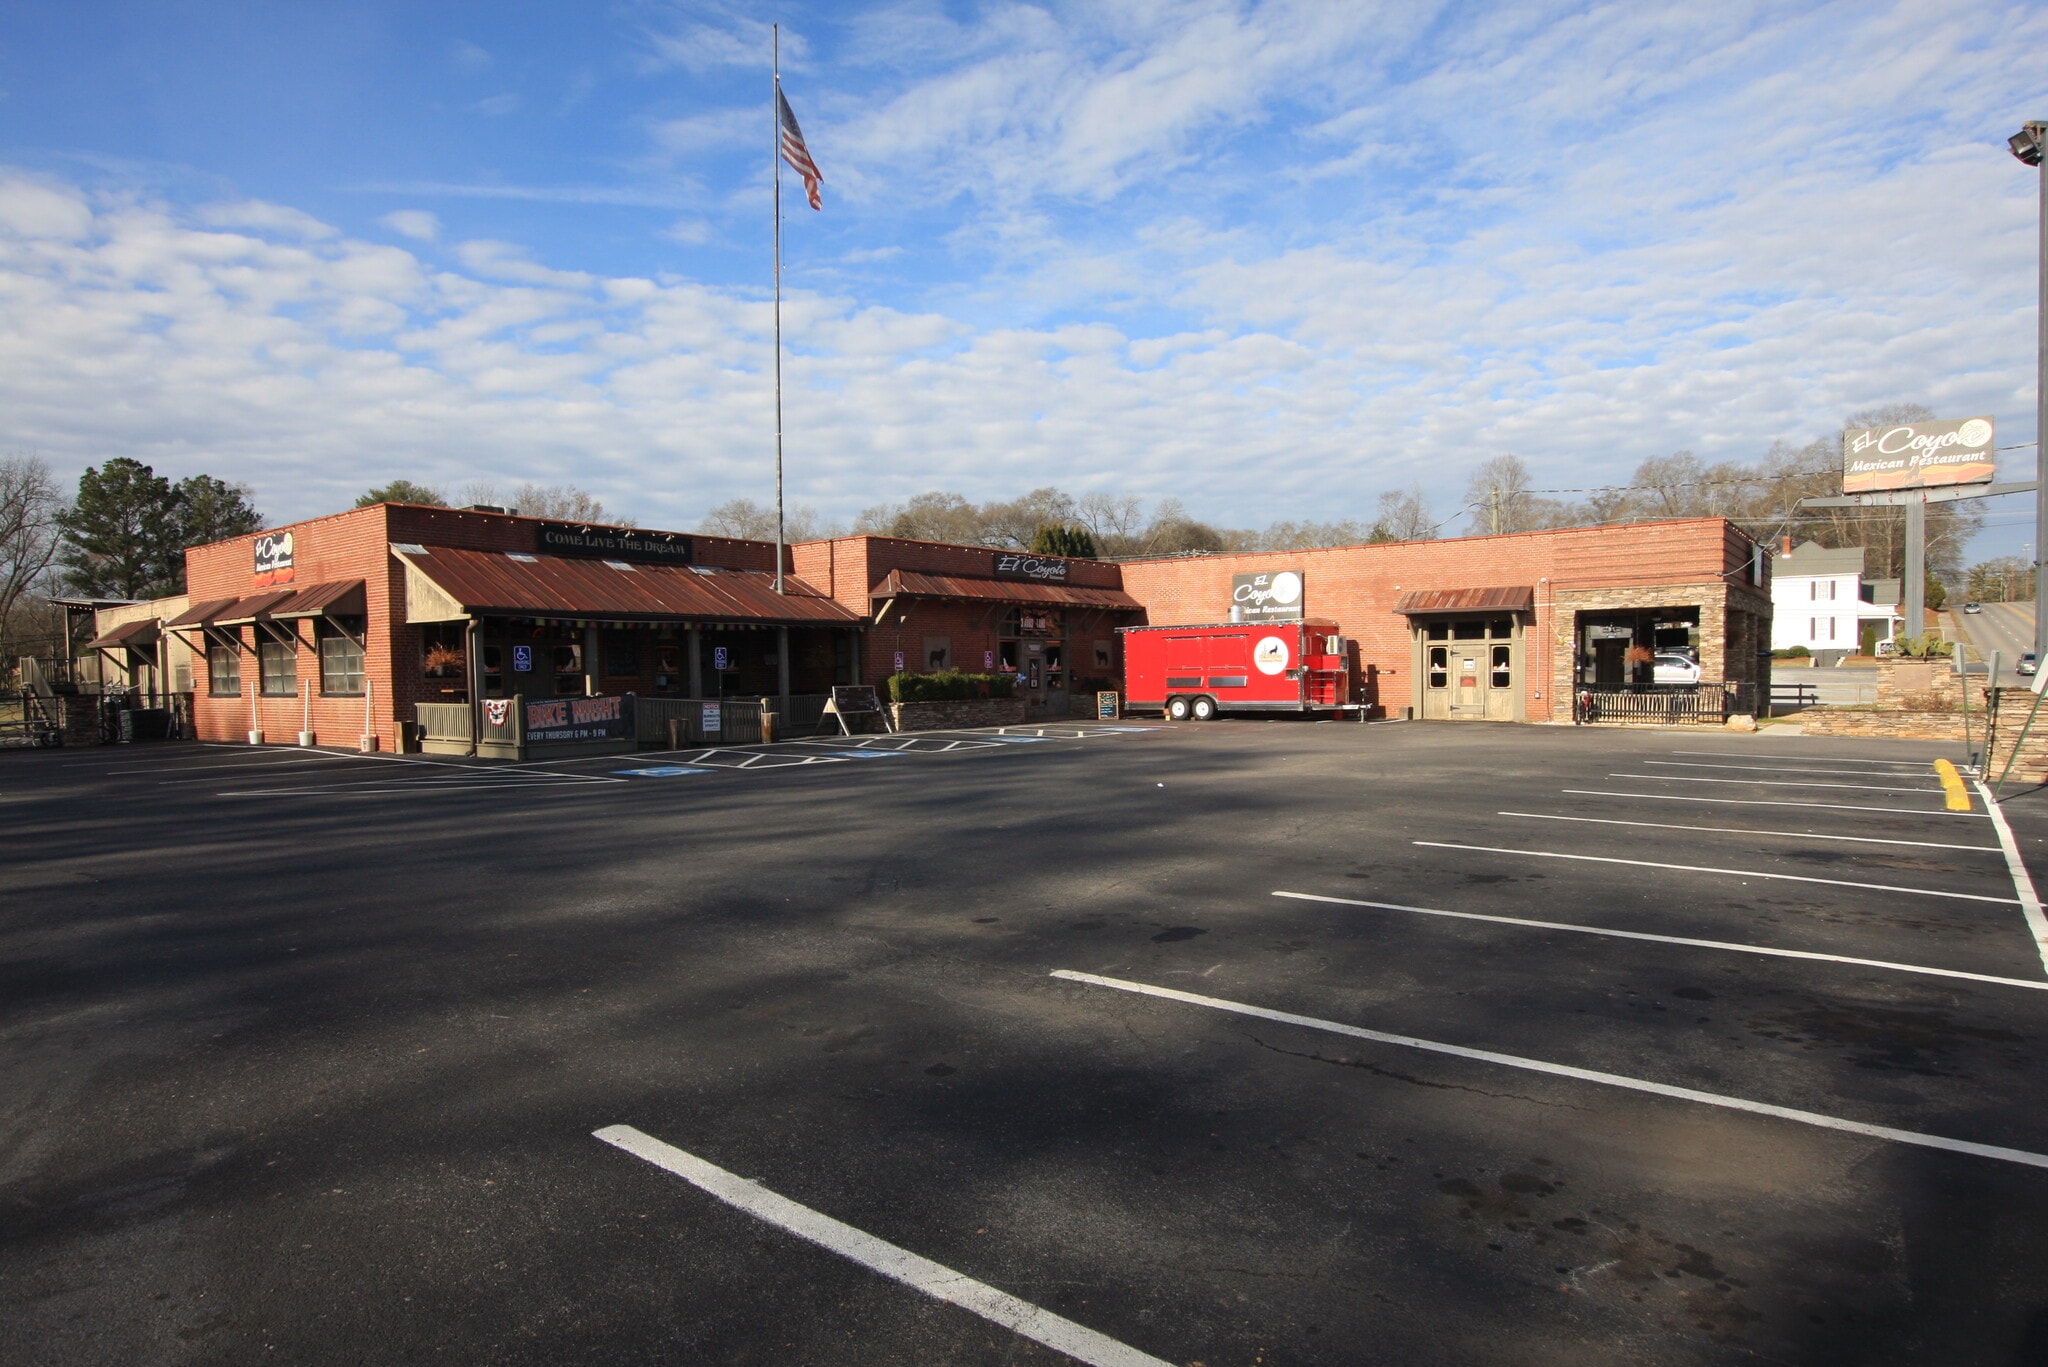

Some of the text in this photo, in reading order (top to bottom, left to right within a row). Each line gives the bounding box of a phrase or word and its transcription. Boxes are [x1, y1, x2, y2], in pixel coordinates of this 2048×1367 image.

[1850, 451, 1986, 472] Mexican Restaurant
[619, 538, 642, 551] THE
[998, 557, 1067, 579] El Coyote
[1262, 605, 1301, 614] Restaurant
[527, 696, 622, 730] BIKE NIGHT
[527, 731, 545, 741] EVERY
[545, 730, 574, 740] THURSDAY
[574, 731, 579, 739] 6
[579, 730, 588, 739] PM
[592, 729, 597, 737] 9
[597, 729, 606, 737] PM
